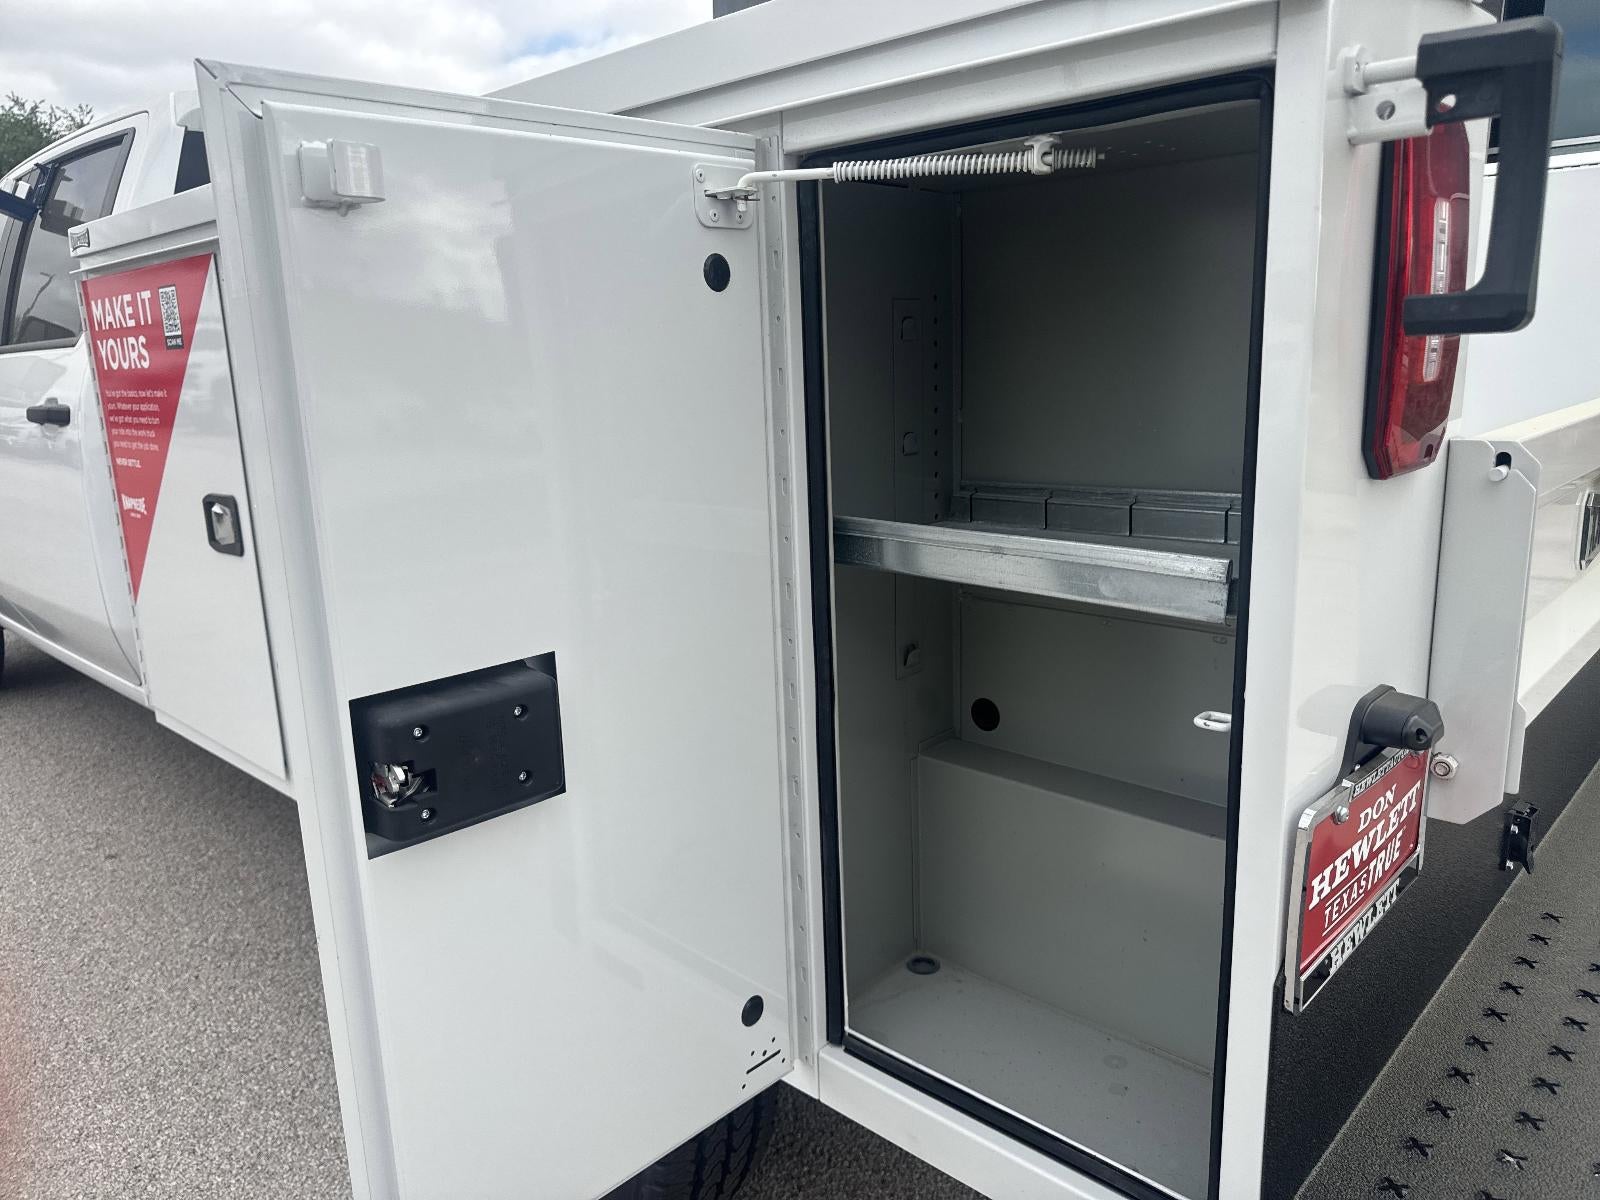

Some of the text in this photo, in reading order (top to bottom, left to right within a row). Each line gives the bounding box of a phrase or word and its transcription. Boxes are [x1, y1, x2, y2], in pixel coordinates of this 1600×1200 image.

[91, 289, 152, 332] MAKE IT
[97, 335, 150, 371] YOURS
[1357, 783, 1397, 833] DON
[1308, 780, 1422, 911] HEWLETT
[1329, 877, 1400, 978] HEWLETT
